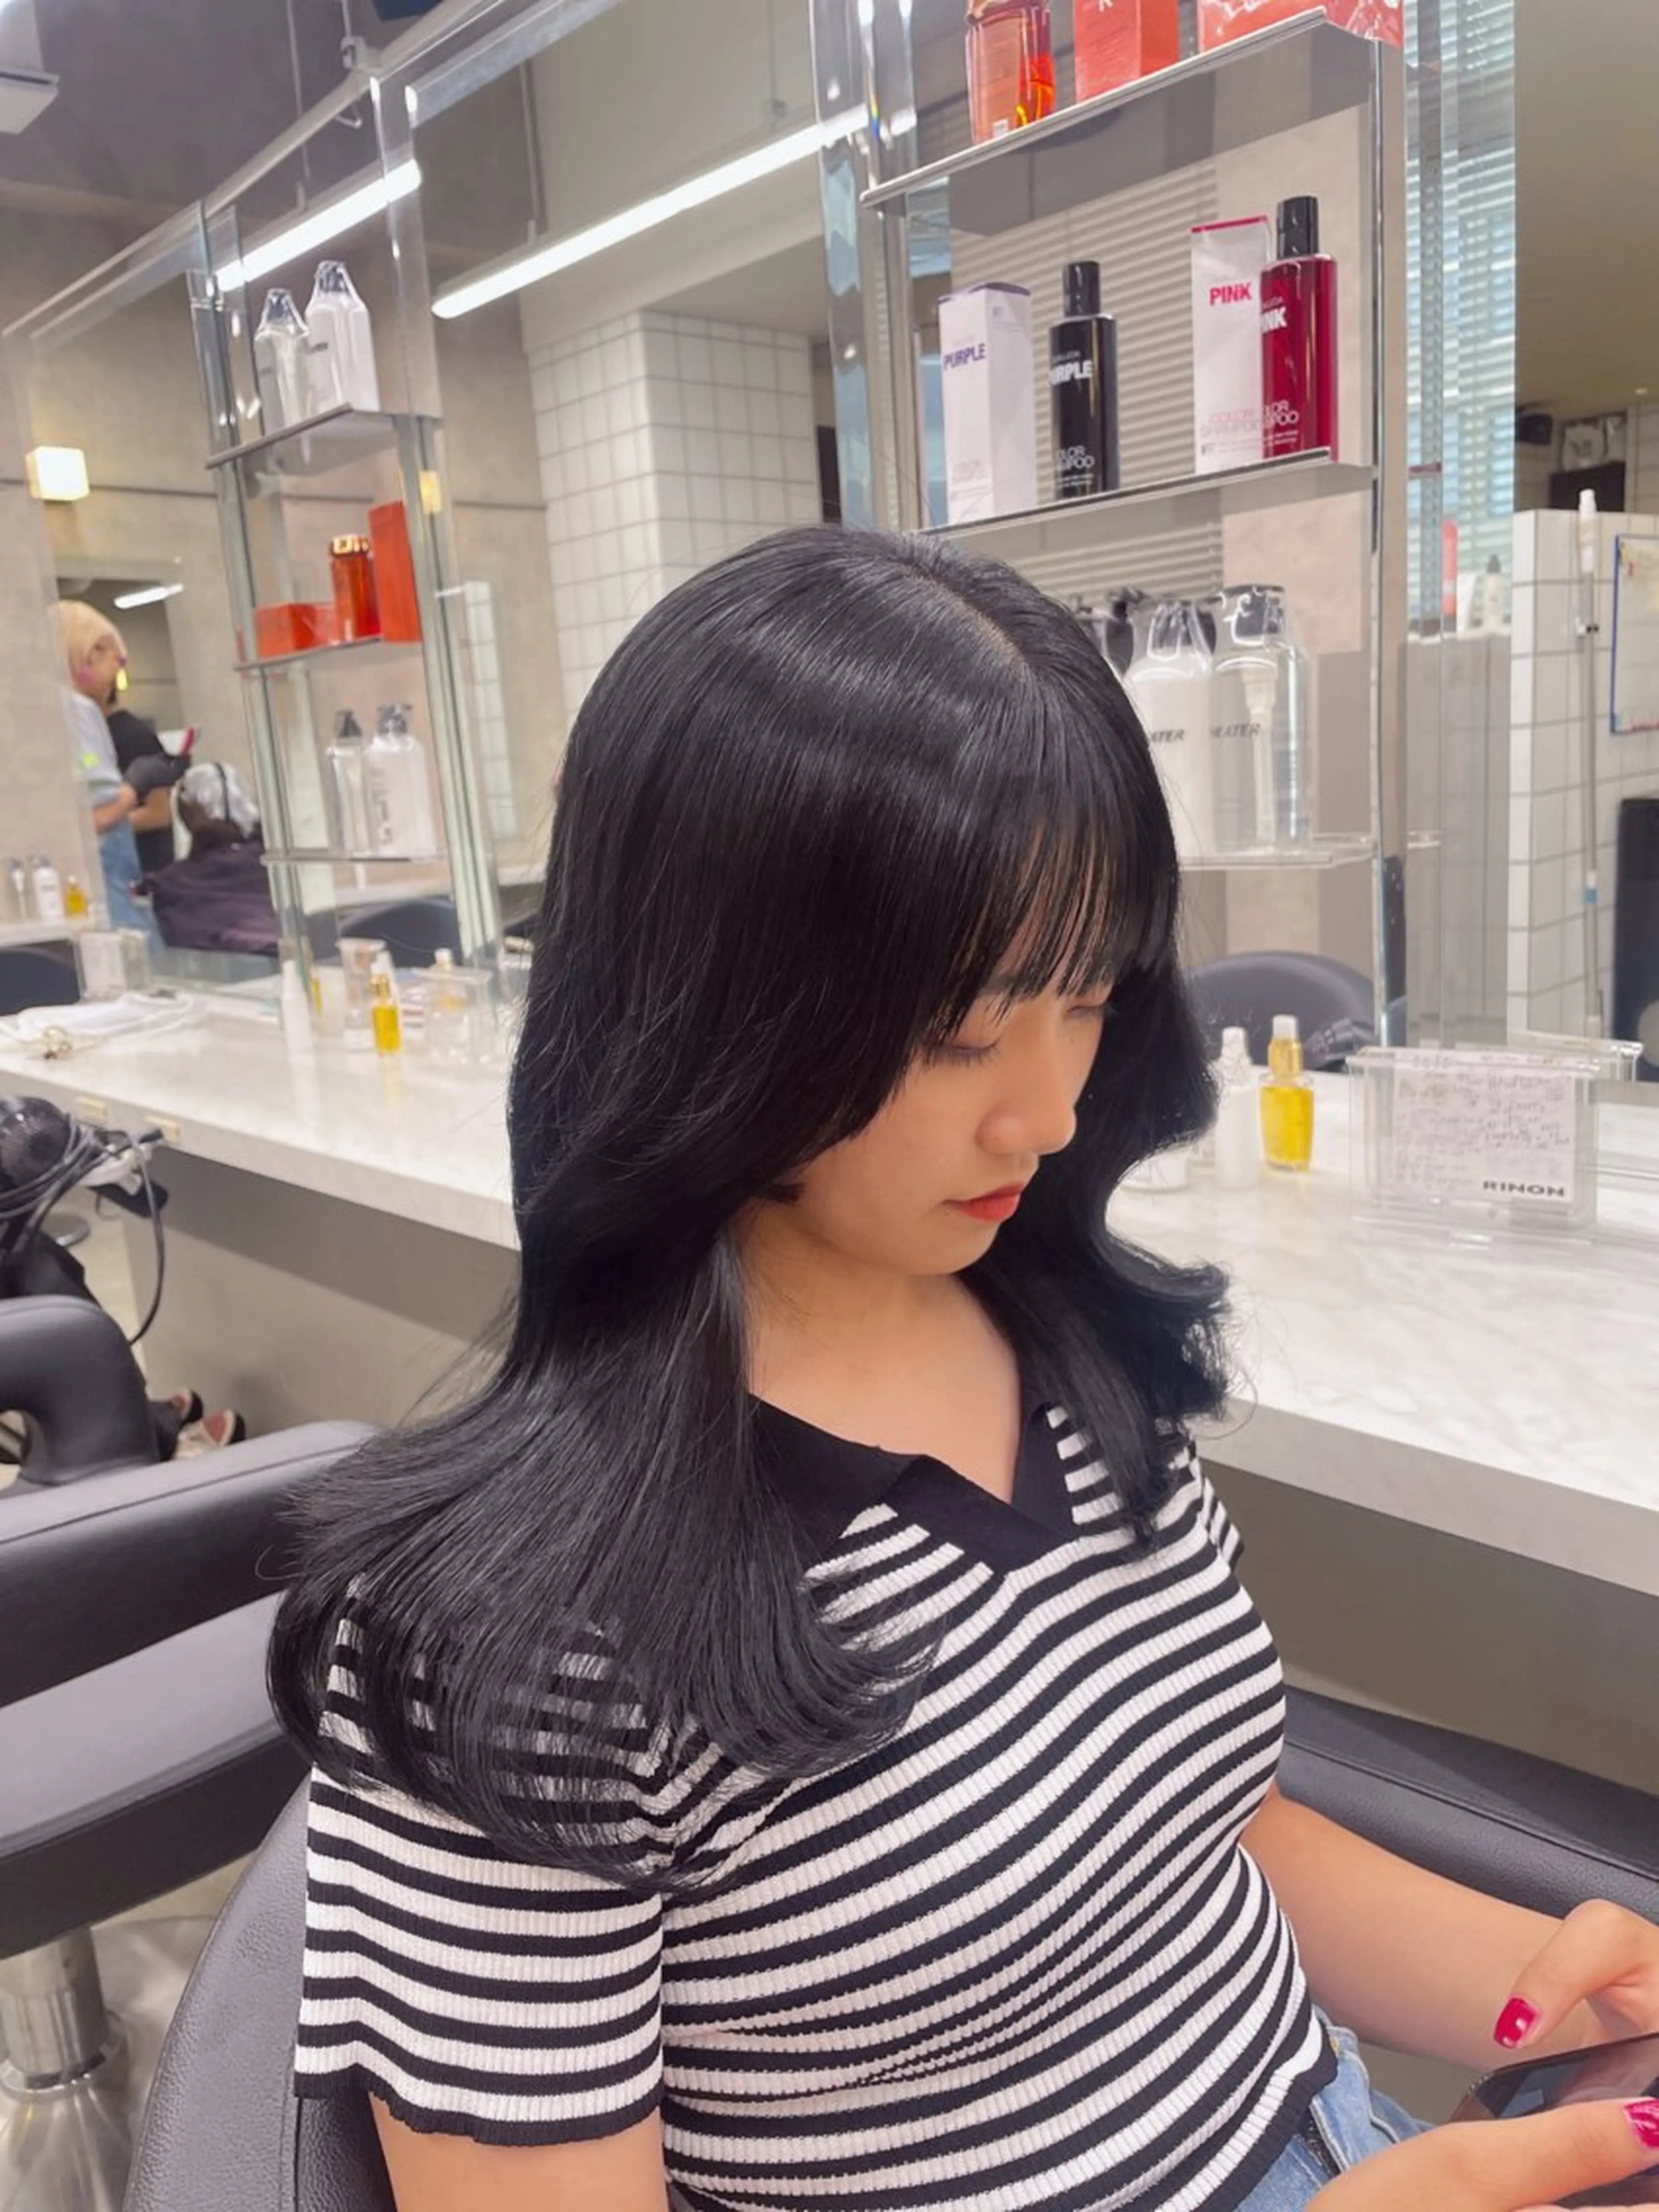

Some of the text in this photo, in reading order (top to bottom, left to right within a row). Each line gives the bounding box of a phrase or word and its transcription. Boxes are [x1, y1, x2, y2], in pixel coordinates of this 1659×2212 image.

[1208, 282, 1252, 306] PINK
[944, 342, 986, 370] PURPLE
[1483, 1180, 1564, 1198] RINON
